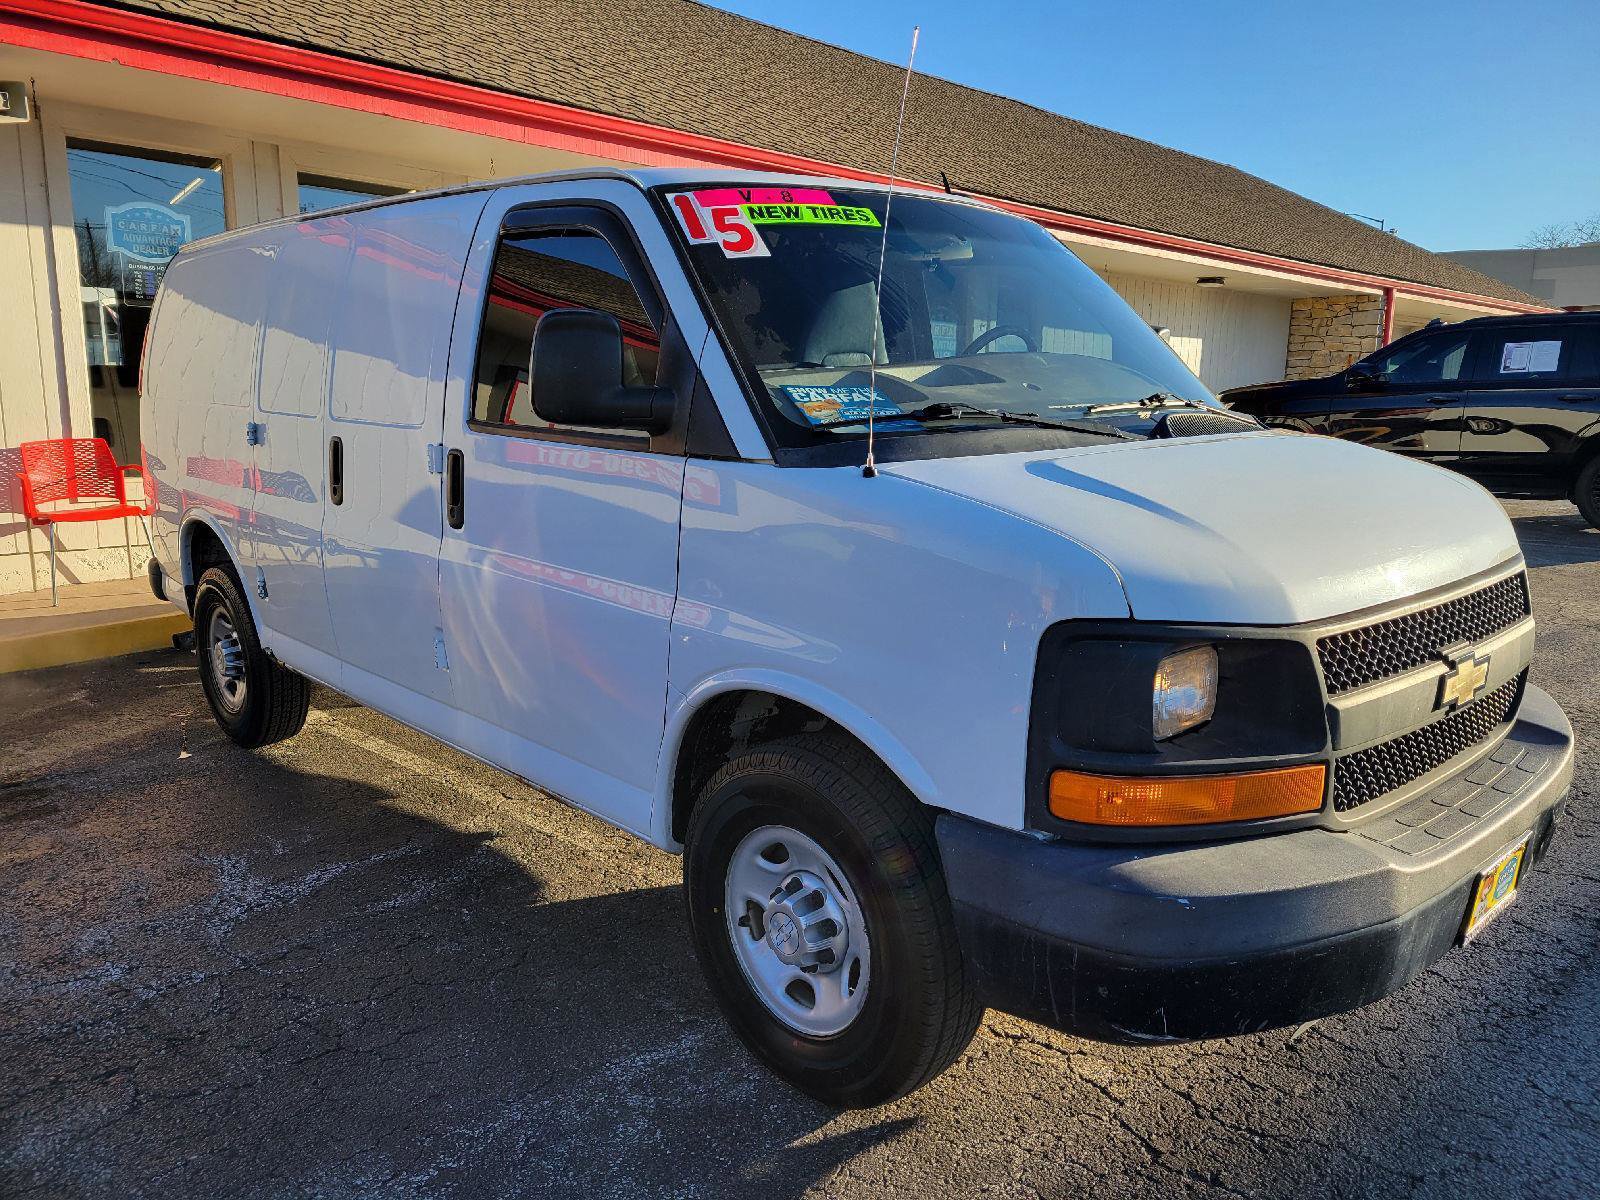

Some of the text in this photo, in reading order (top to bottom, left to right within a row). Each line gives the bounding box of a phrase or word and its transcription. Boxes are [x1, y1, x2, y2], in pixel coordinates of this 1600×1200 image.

[738, 190, 751, 202] V
[780, 190, 793, 202] 8
[750, 205, 872, 222] NEW TIRES
[119, 221, 181, 236] CARFAX
[674, 195, 755, 252] 15
[123, 233, 178, 247] ADVANTAGE
[133, 244, 170, 255] DEALER
[792, 392, 885, 402] CARFAX
